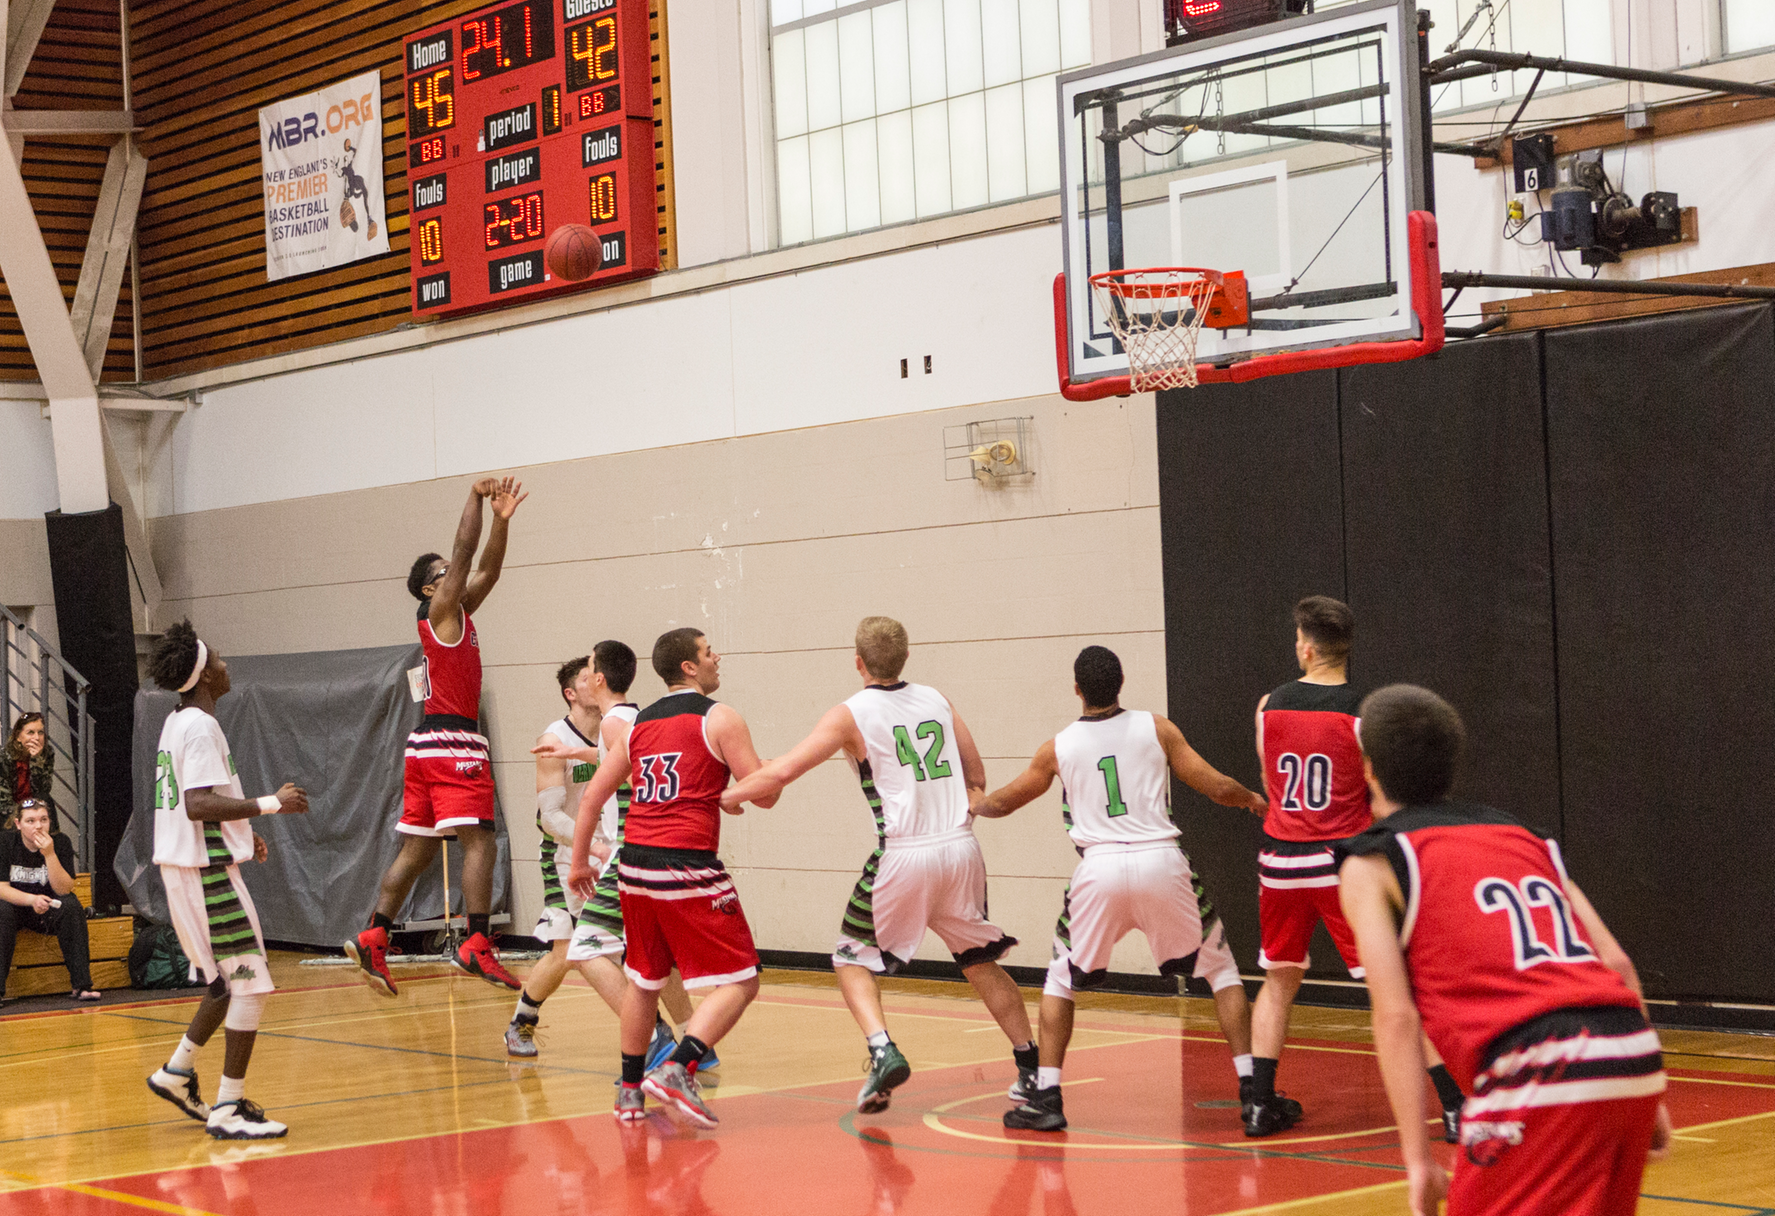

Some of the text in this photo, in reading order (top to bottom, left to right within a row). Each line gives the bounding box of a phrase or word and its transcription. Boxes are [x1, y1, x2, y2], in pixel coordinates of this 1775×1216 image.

[412, 39, 447, 70] Home
[462, 5, 533, 80] 24.1
[571, 17, 616, 80] 42
[413, 69, 453, 128] 45
[552, 89, 560, 127] 1
[268, 92, 374, 153] MBR.ORG
[489, 105, 531, 146] period
[585, 131, 618, 163] fouls
[266, 157, 329, 183] NEW ENGLAND'S
[267, 172, 329, 204] PREMIER
[491, 156, 534, 190] player
[1527, 170, 1537, 189] 6
[268, 197, 330, 225] BASKETBALL
[415, 179, 443, 208] fouls
[590, 175, 615, 220] 10
[419, 219, 442, 261] 10
[485, 194, 542, 247] 2-20
[602, 239, 620, 262] on
[422, 279, 446, 302] won
[500, 259, 533, 290] game
[893, 719, 953, 782] 42
[635, 751, 683, 804] 33
[1097, 754, 1129, 818] 1
[1277, 752, 1333, 812] 20
[1473, 874, 1600, 972] 22
